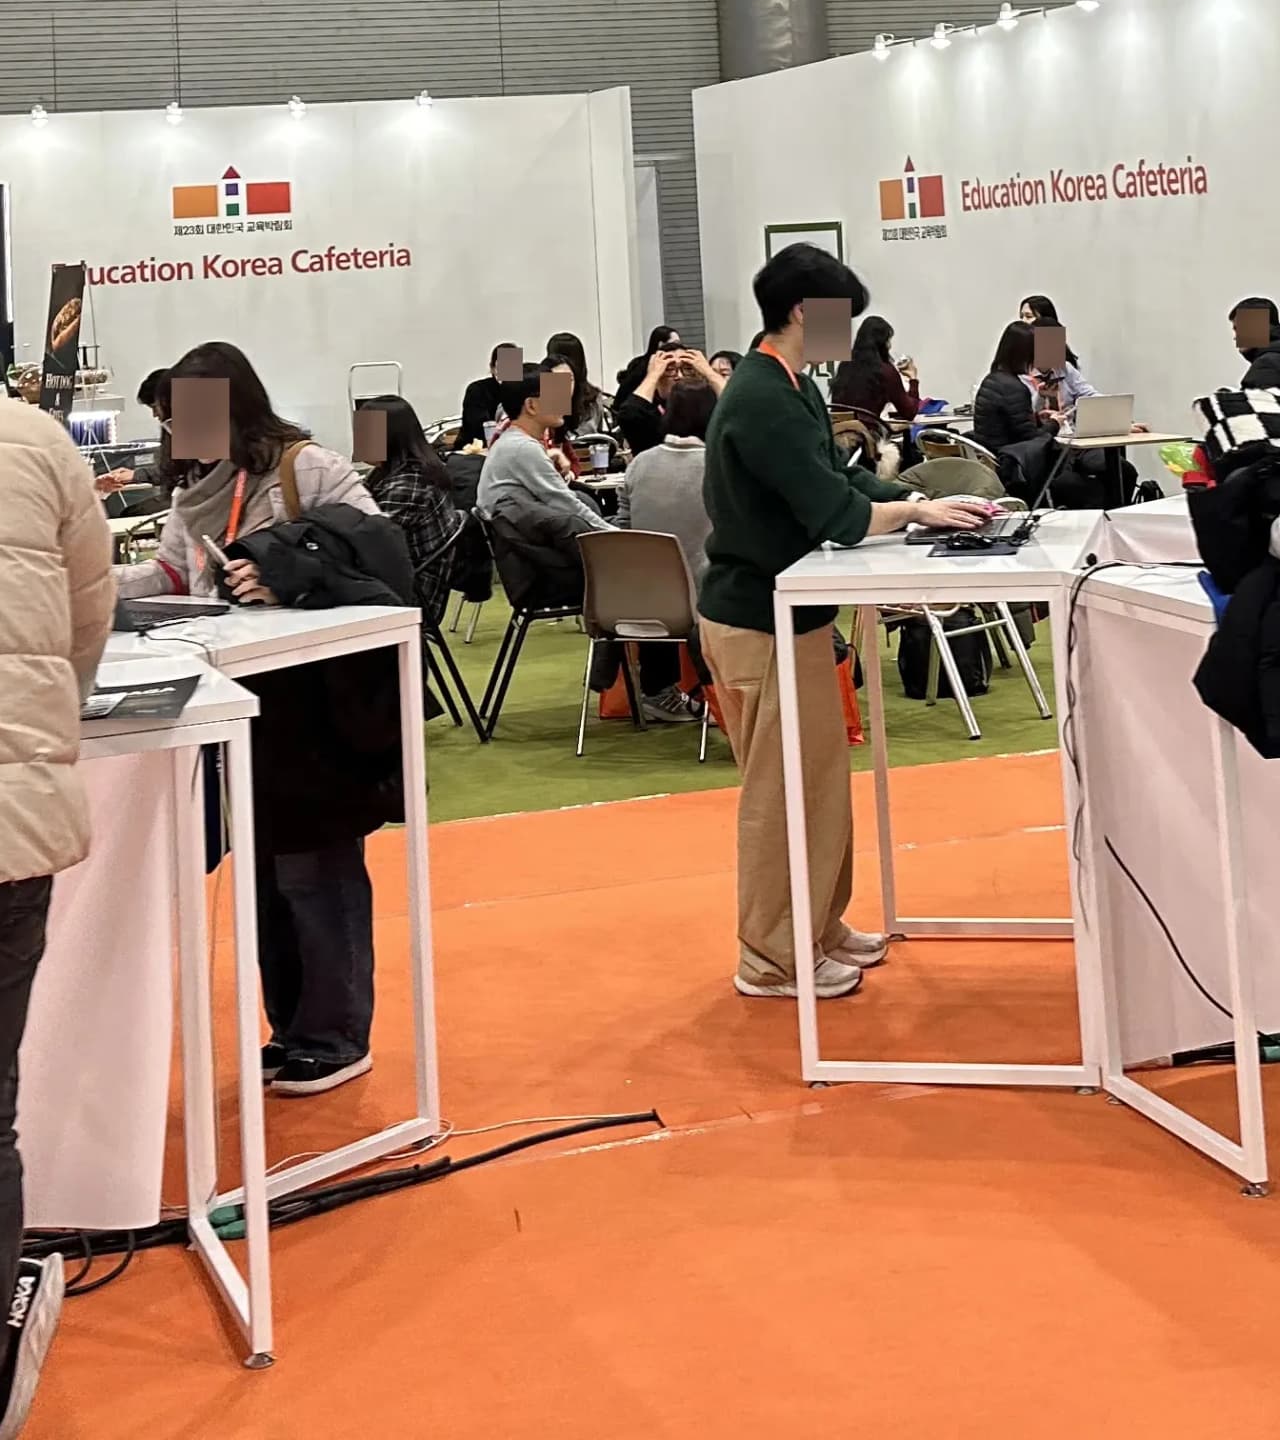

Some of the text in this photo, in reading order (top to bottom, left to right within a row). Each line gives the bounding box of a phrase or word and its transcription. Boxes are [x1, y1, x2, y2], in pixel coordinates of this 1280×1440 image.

[960, 156, 1208, 212] Education Korea Cafeteria
[174, 220, 293, 236] 제23회 대한민국 교육박람회
[87, 243, 411, 285] ucation Korea Cafeteria
[6, 1276, 36, 1328] HOKA
